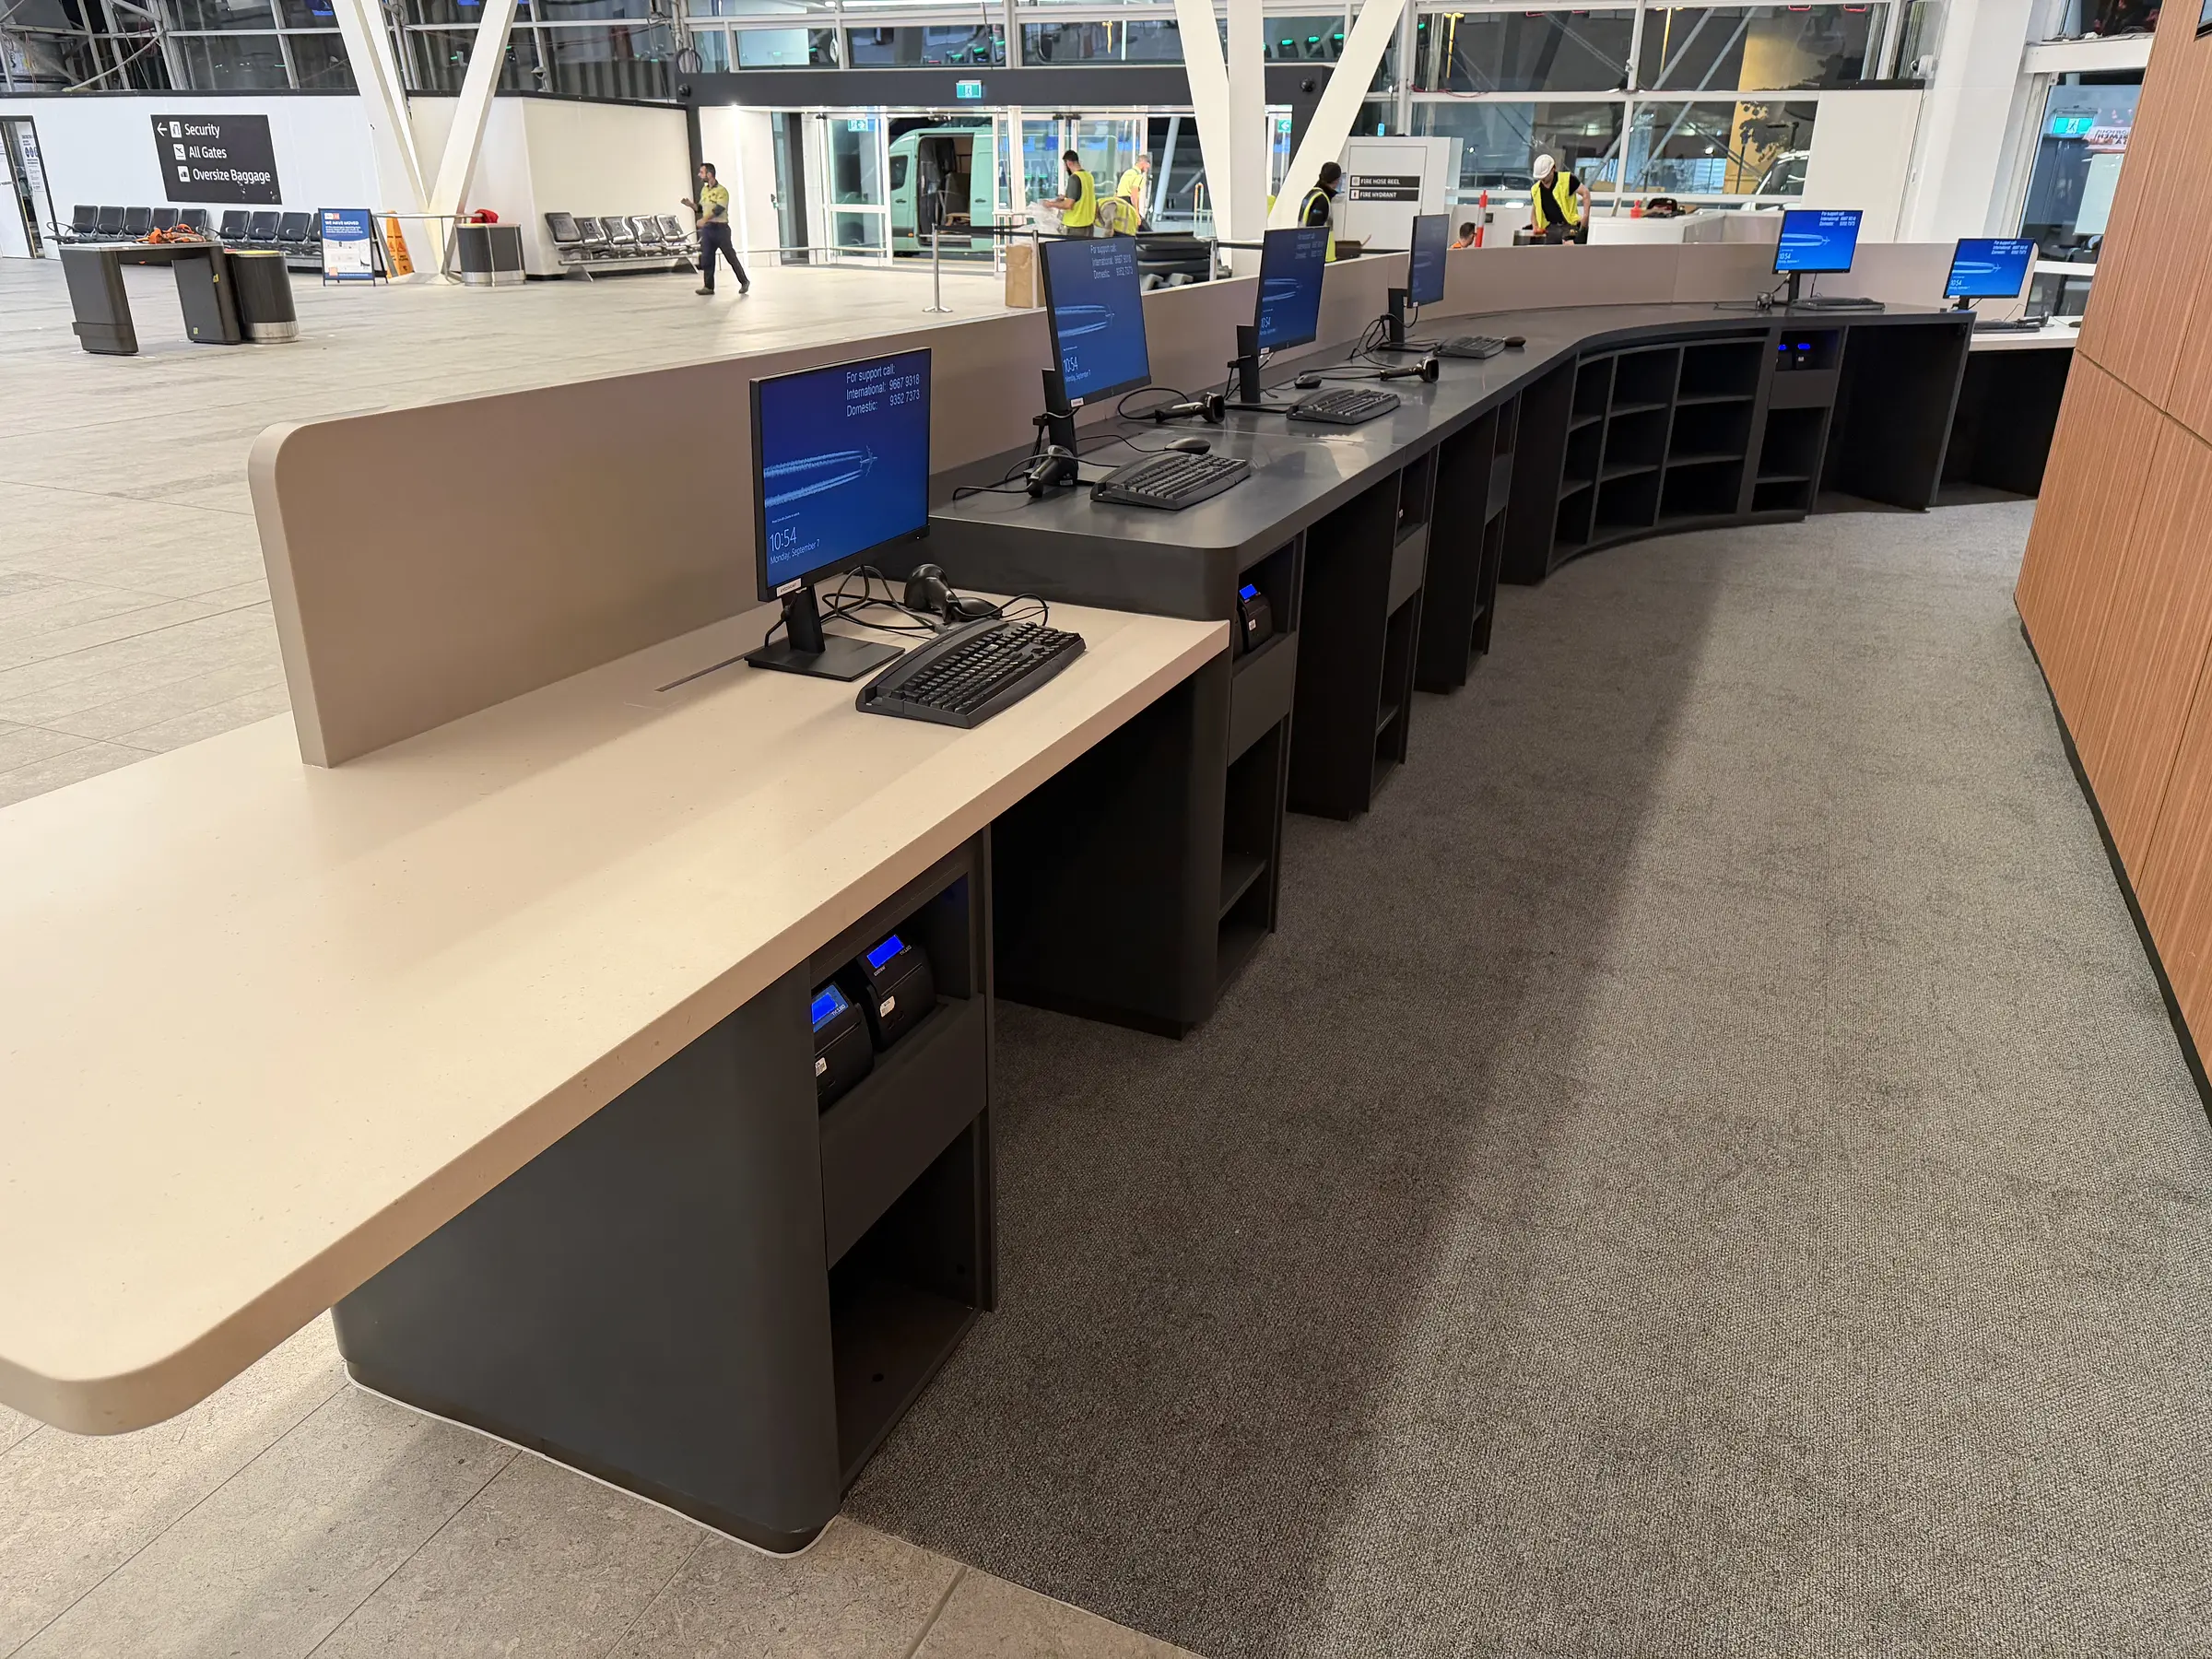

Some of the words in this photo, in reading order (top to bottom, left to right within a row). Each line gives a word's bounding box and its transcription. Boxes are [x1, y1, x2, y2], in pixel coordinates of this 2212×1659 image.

[184, 124, 220, 138] Security
[189, 146, 201, 159] All
[202, 147, 228, 159] Gates
[193, 169, 229, 181] Oversize
[230, 170, 271, 184] Baggage
[846, 371, 858, 383] For
[858, 367, 882, 382] support
[882, 363, 896, 376] call:
[1064, 356, 1077, 373] 10:54
[846, 382, 887, 400] International:
[888, 377, 904, 390] 9667
[905, 373, 920, 387] 9318
[846, 400, 878, 417] Domestic:
[889, 393, 904, 406] 9352
[905, 389, 920, 402] 7373
[770, 526, 797, 551] 10:54
[770, 552, 791, 565] Monday,
[792, 542, 817, 558] September
